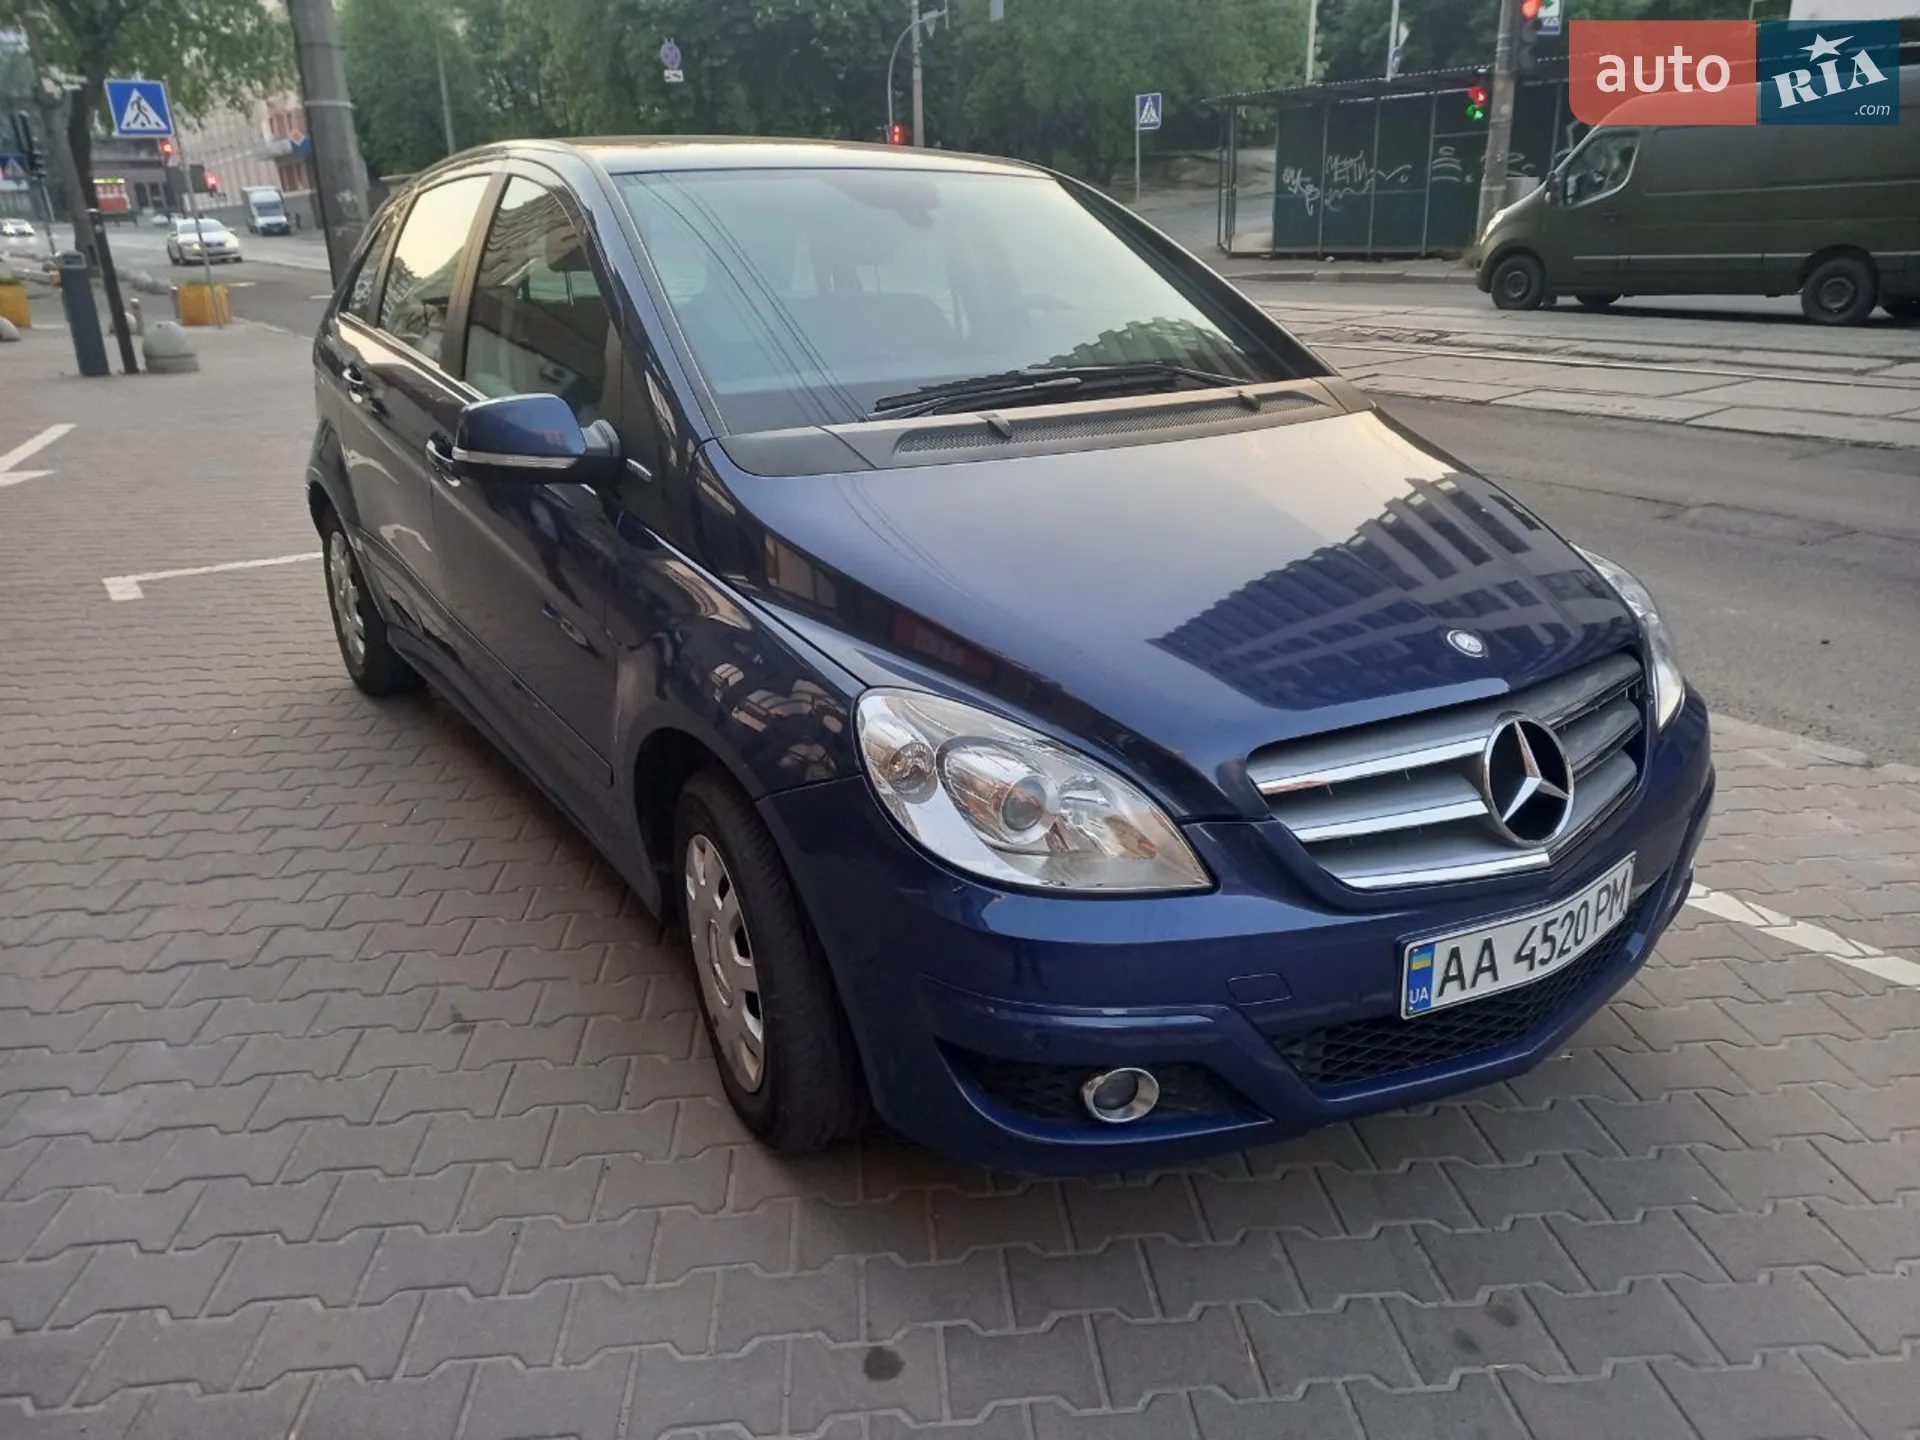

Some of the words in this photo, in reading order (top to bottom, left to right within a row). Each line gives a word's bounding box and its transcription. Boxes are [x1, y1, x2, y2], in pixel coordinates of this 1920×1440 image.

[1437, 937, 1499, 997] AA
[1514, 900, 1589, 972] 4520
[1593, 869, 1629, 934] PM
[1409, 986, 1429, 1005] UA
